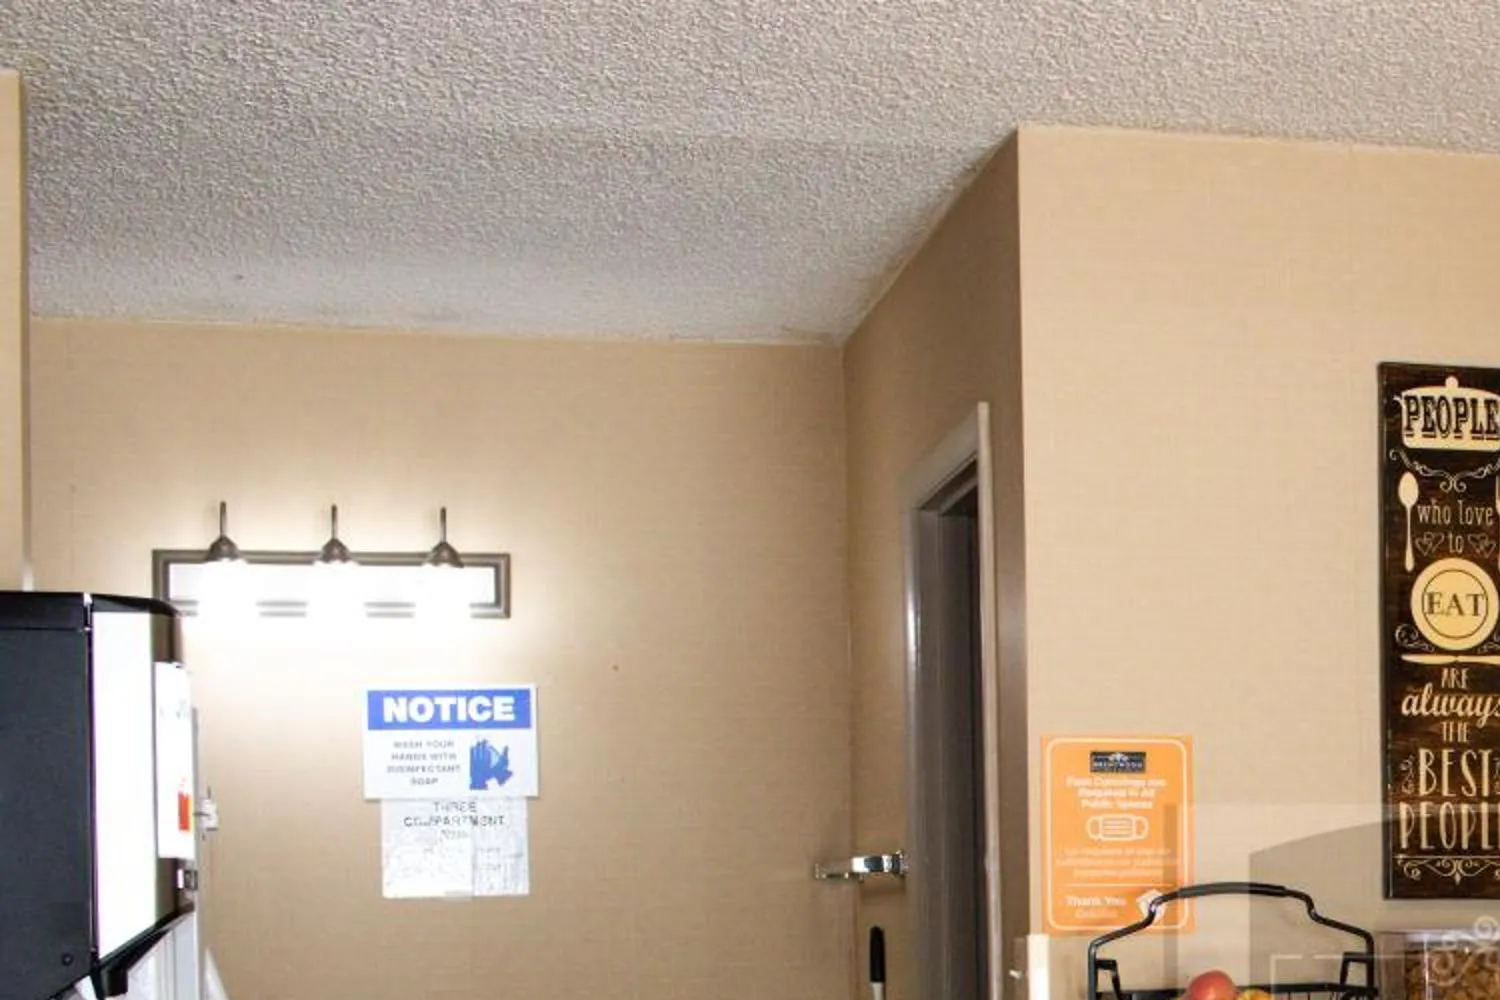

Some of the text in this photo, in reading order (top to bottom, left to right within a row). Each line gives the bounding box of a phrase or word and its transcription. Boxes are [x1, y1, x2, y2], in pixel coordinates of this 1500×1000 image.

[1404, 394, 1500, 440] PEOPLE
[1417, 498, 1494, 526] who love
[1447, 531, 1464, 554] to
[1424, 591, 1485, 617] EAT
[1441, 667, 1470, 689] ARE
[382, 695, 517, 724] NOTICE
[1441, 721, 1470, 743] THE
[426, 740, 455, 749] YOUR
[430, 752, 458, 761] WITH
[1418, 748, 1494, 797] BEST
